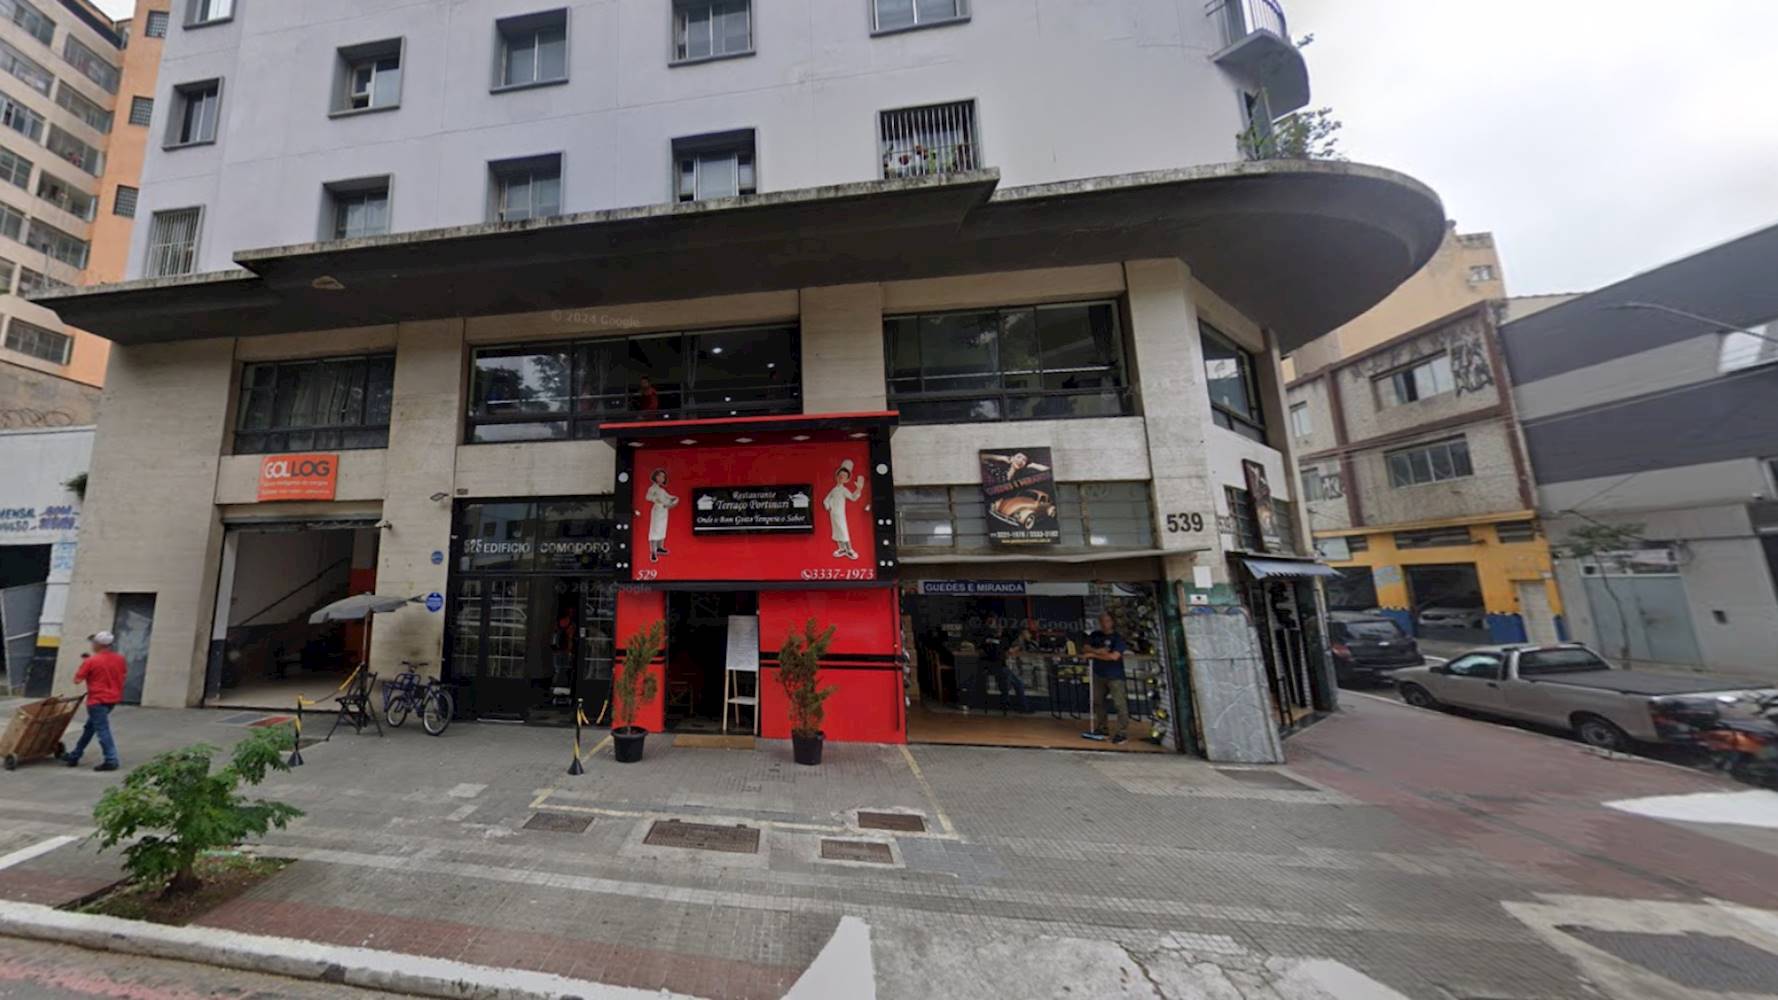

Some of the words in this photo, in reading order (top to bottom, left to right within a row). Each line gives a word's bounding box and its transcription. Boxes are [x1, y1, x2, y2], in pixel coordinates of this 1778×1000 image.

[732, 491, 776, 500] Restaurante
[749, 499, 790, 510] Portinari
[1167, 513, 1203, 532] 539
[464, 539, 483, 553] 525
[484, 542, 531, 553] EDIFICIO
[540, 542, 611, 553] COMODORO
[637, 569, 658, 581] 529
[811, 568, 874, 581] 3337-1973
[925, 582, 966, 593] GUEDES
[967, 582, 974, 592] E
[976, 582, 1024, 592] MIRANDA
